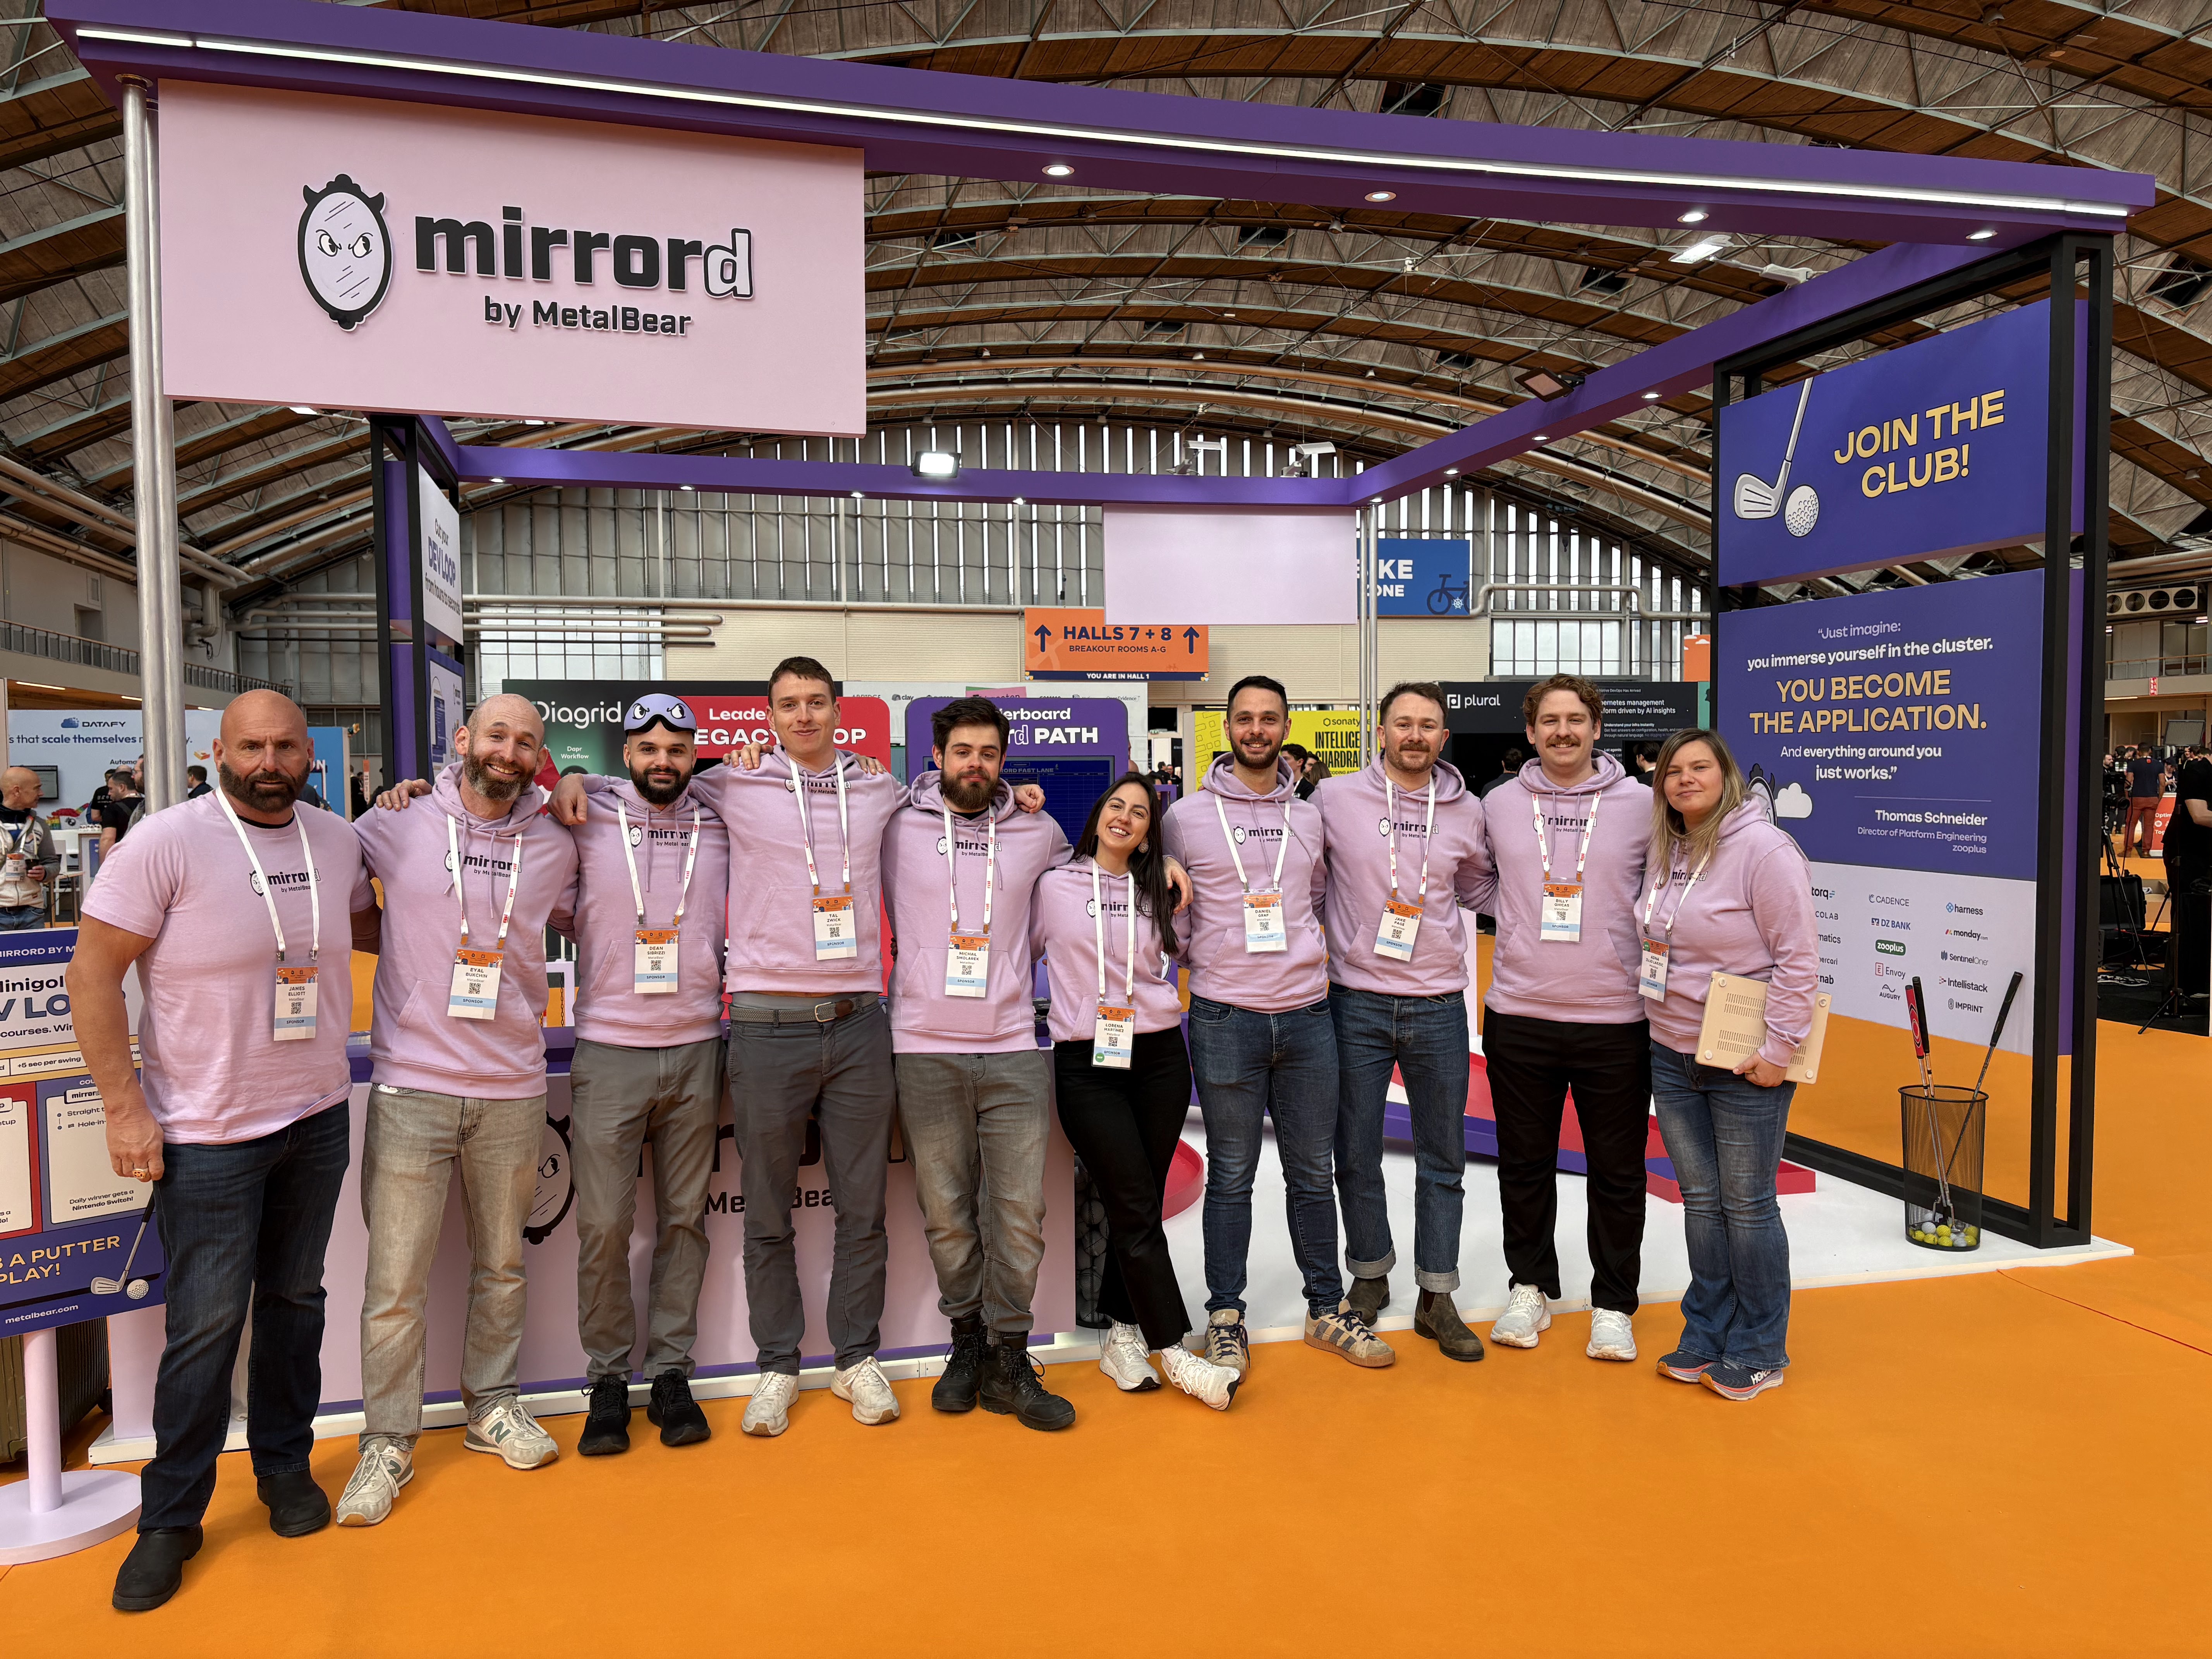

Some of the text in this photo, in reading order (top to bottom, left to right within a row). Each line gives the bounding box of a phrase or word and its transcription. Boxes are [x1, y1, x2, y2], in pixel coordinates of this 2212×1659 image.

[415, 206, 754, 299] mirrord
[485, 296, 692, 336] by MetalBear
[1834, 389, 2004, 464] JOIN THE
[1862, 444, 1970, 498] CLUB!
[428, 536, 455, 588] DEV LOOP
[1064, 626, 1123, 640] HALLS
[1129, 627, 1139, 640] 7
[1161, 627, 1171, 641] 8
[1850, 621, 1901, 637] imagine:
[1747, 636, 1993, 671] you immerse yourself in the cluster.
[1776, 669, 1951, 703] YOU BECOME
[1464, 694, 1501, 708] plural
[1000, 708, 1071, 720] erboard
[1750, 703, 1987, 734] THE APPLICATION.
[1332, 718, 1370, 726] sonatye
[17, 735, 39, 744] that
[42, 735, 70, 744] scale
[73, 735, 136, 744] themselves
[1035, 727, 1098, 744] PATH
[1315, 731, 1370, 749] INTELLIGE
[1781, 745, 1942, 760] And everything around you
[1816, 764, 1842, 781] just
[1875, 810, 1988, 826] Thomas Schneider
[1249, 827, 1295, 836] mirrod
[1858, 827, 1987, 844] Director of Platform Engineering
[1952, 844, 1987, 854] zooplus
[463, 855, 522, 873] mirror
[1812, 887, 1828, 900] torq
[1876, 895, 1910, 907] CADENCE
[1815, 911, 1839, 920] COLAB
[1954, 903, 1983, 915] harness
[1881, 919, 1911, 930] DZ BANK
[1877, 942, 1904, 953] zooplus
[1949, 953, 1989, 966] SentinelOne
[1819, 974, 1834, 985] nab
[1885, 967, 1906, 979] Envoy
[1948, 977, 1988, 993] Intellistack
[1879, 991, 1901, 1001] AUGURY
[1955, 1001, 1984, 1013] IMPRINT
[0, 1026, 52, 1038] courses.
[67, 1108, 101, 1116] Straight
[72, 1196, 133, 1211] Nintendo Switch!
[88, 1193, 111, 1201] winner
[9, 1253, 26, 1267] A
[32, 1235, 120, 1263] PUTTER
[5, 1304, 79, 1324] metalbear.com
